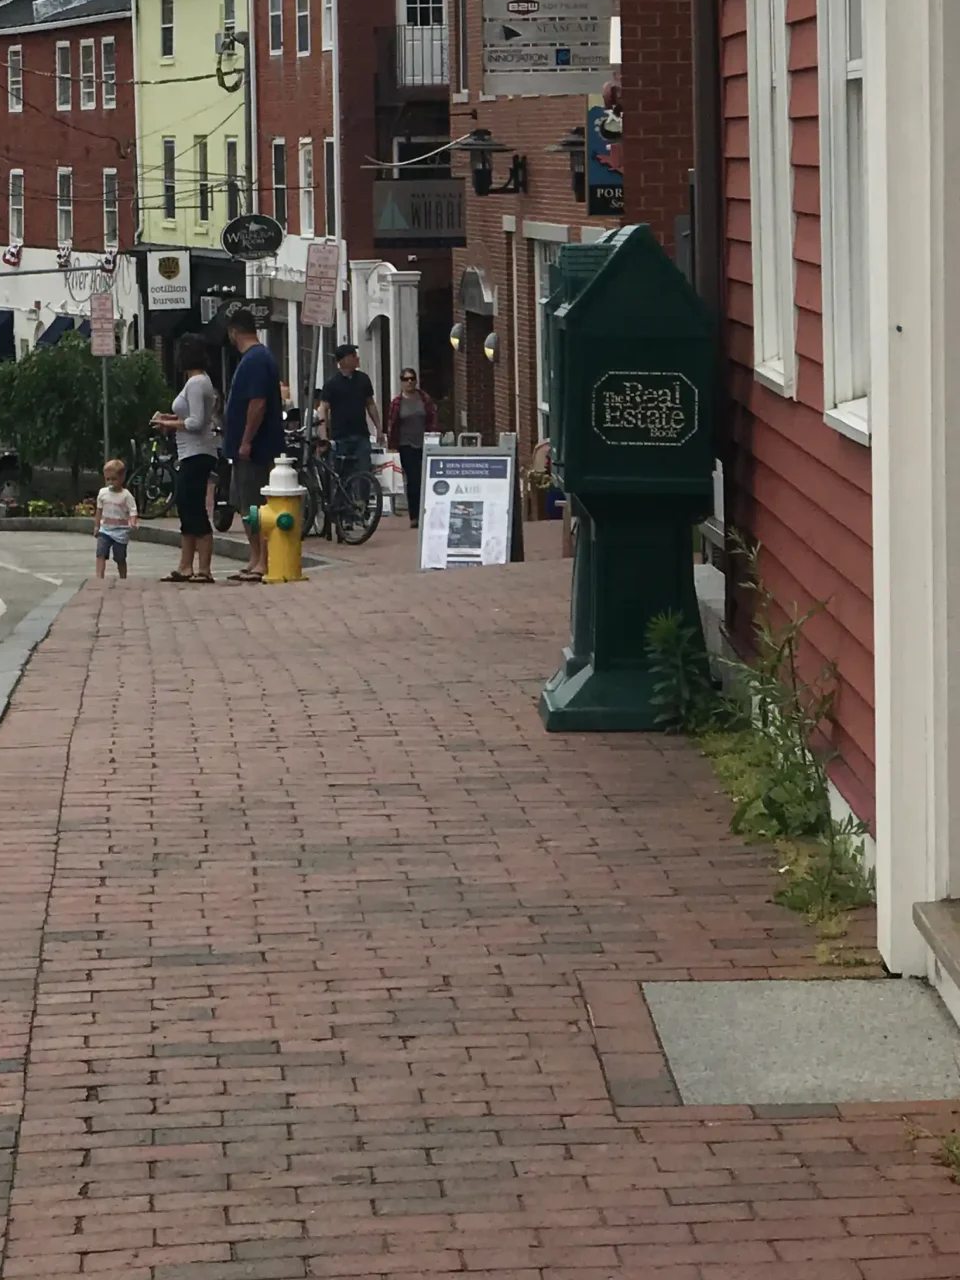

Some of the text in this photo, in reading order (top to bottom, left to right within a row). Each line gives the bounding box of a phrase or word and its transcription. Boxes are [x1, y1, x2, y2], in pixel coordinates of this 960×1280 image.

[150, 284, 188, 293] cotillion
[152, 296, 186, 305] bureau
[603, 381, 682, 407] The Real
[603, 404, 685, 428] Estate
[650, 427, 677, 438] Book
